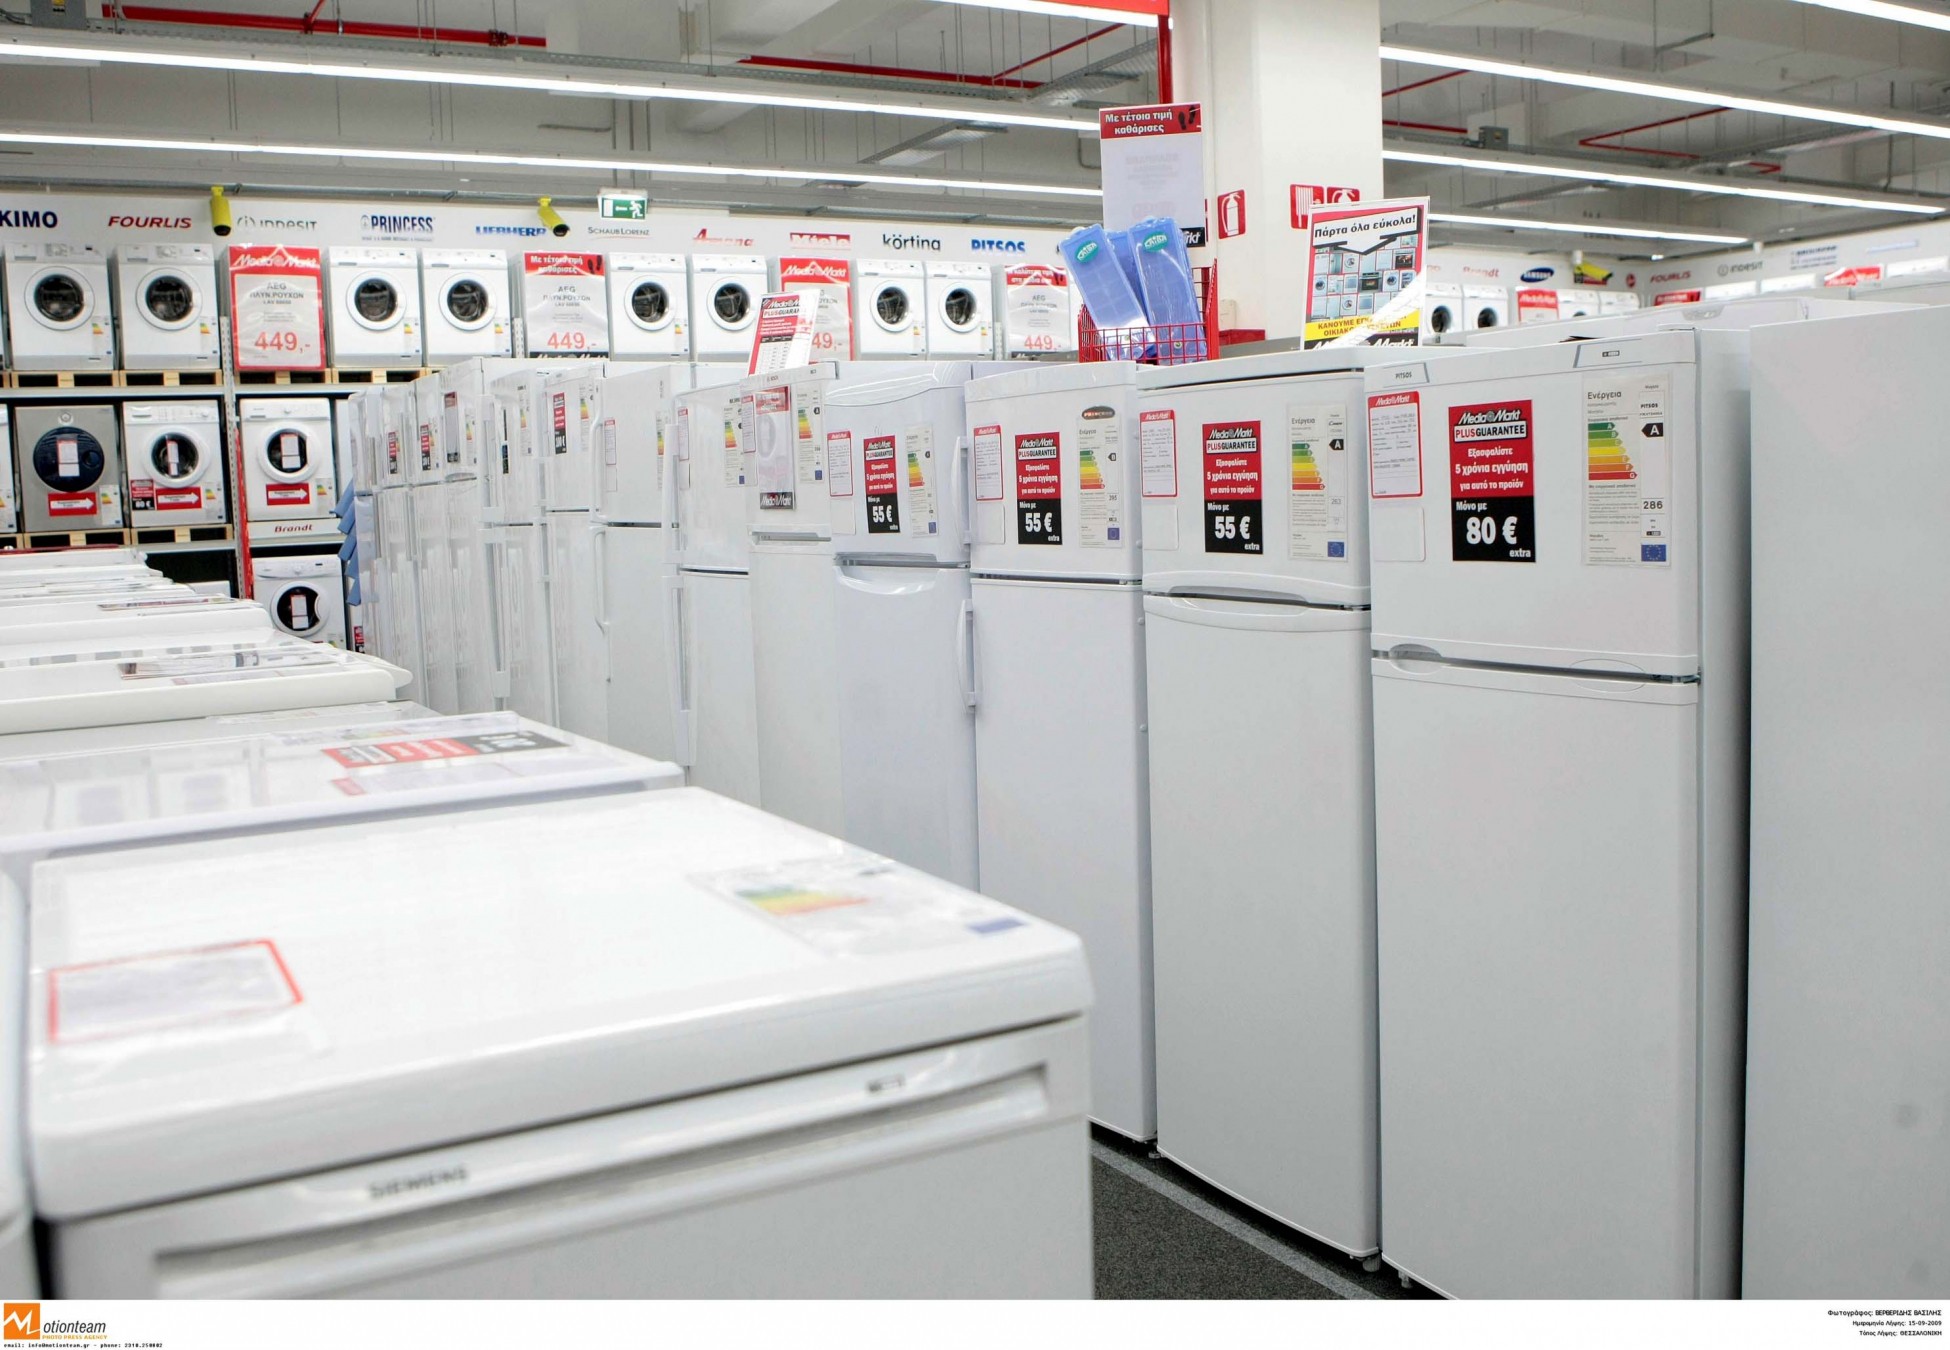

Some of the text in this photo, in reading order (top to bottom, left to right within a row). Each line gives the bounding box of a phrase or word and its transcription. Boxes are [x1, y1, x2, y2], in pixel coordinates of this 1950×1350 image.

[1106, 109, 1172, 122] Με τέτοια τιμή
[1114, 124, 1164, 134] καθάρισες
[108, 216, 192, 229] FOURLIS
[371, 215, 434, 233] PRINCESS
[1314, 214, 1416, 238] Πάρτα όλα εύκολα!
[971, 239, 1026, 252] PITSOS
[1650, 270, 1692, 282] FOURLIS
[1318, 319, 1354, 330] ΚΑΝΟΥΜΕ
[1588, 390, 1622, 400] Ενέργεια
[1292, 418, 1316, 426] Ενέργεια
[1650, 424, 1660, 436] A
[1334, 440, 1342, 448] A
[1468, 446, 1514, 458] Εξασφαλίστε
[1456, 460, 1528, 476] 5 χρόνια εγγύηση
[1018, 474, 1022, 482] 5
[1206, 470, 1258, 482] 5 χρόνια εγγύηση
[1218, 485, 1230, 493] αυτό
[1460, 483, 1470, 492] για
[1471, 480, 1488, 489] αυτό
[1498, 479, 1524, 490] προϊόν
[1208, 502, 1230, 512] Μόνο με
[1456, 500, 1488, 512] Μόνο με
[1643, 500, 1663, 510] 286
[872, 505, 892, 523] 55 €
[1025, 512, 1053, 532] 55 €
[1214, 516, 1250, 540] 55 €
[274, 525, 313, 533] Brandt
[1466, 516, 1518, 544] 80 €
[1048, 534, 1060, 542] extra
[1510, 548, 1531, 558] extra
